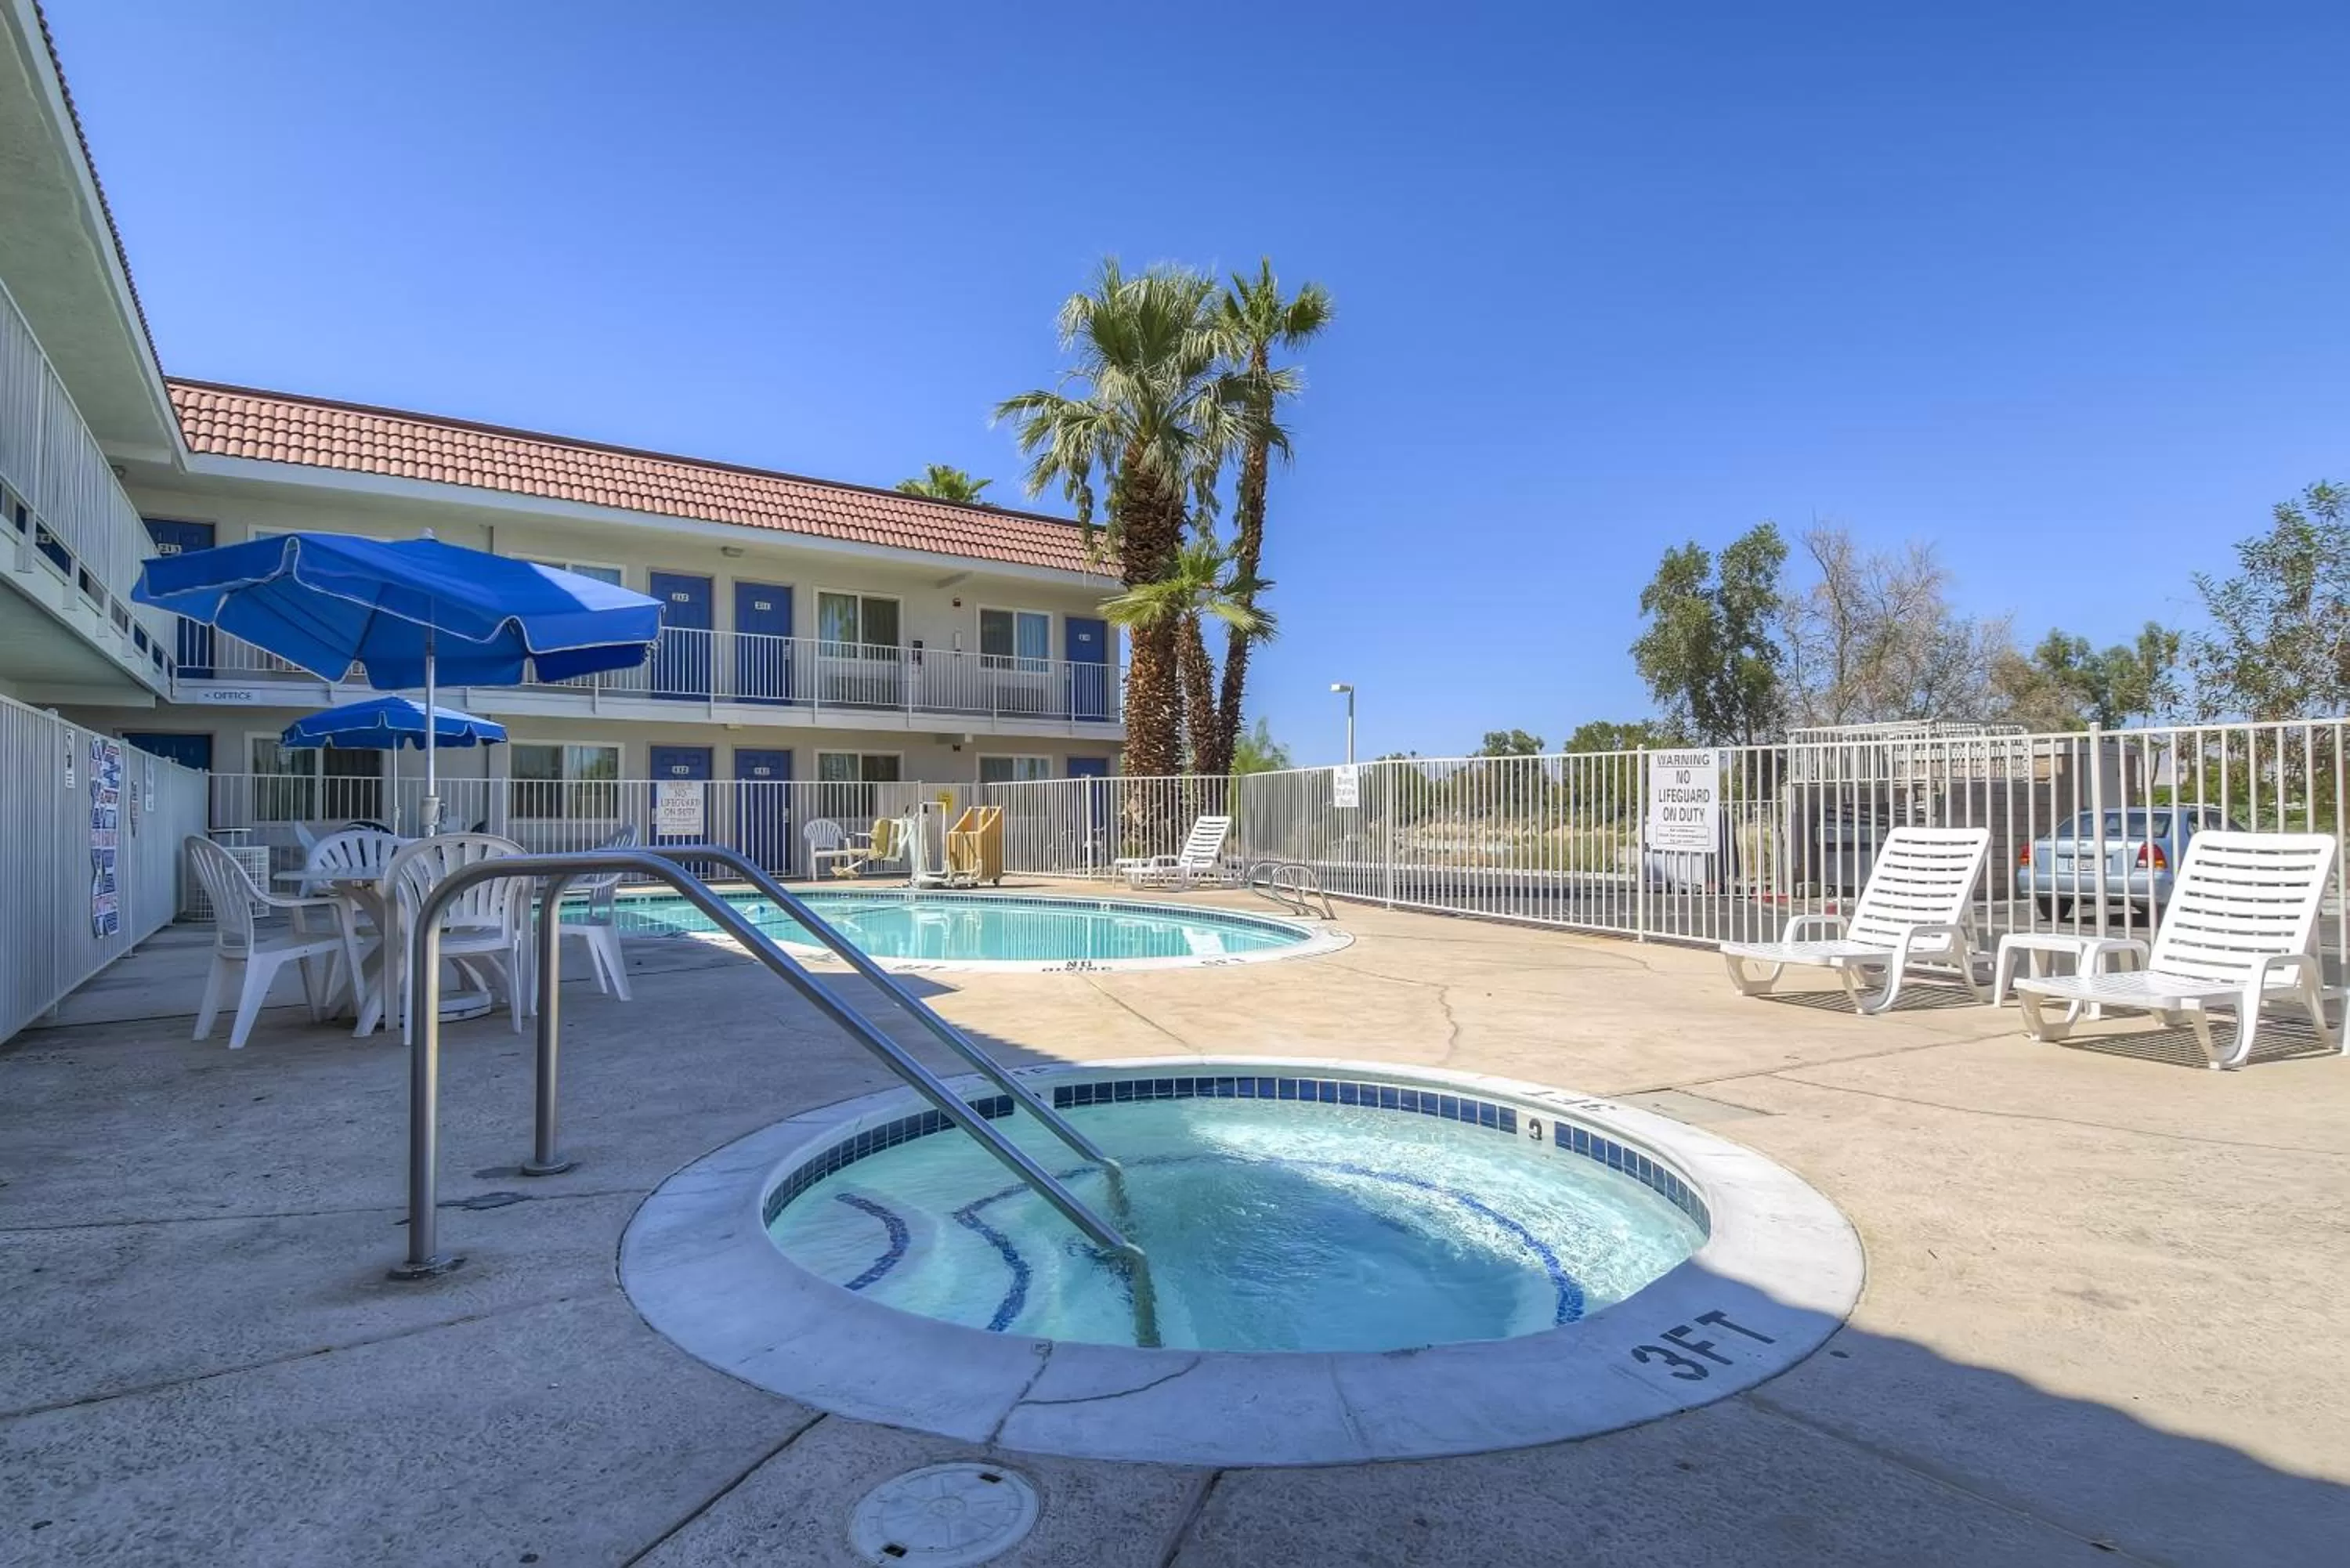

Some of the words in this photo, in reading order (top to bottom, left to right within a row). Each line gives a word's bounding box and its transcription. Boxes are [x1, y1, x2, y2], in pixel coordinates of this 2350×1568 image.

[1657, 754, 1710, 765] WARNING
[1676, 770, 1690, 784] NO
[1658, 789, 1710, 803] LIFEGUARD
[1663, 807, 1676, 822] ON
[1679, 807, 1705, 822] DUTY
[1631, 1310, 1776, 1380] 3FT
